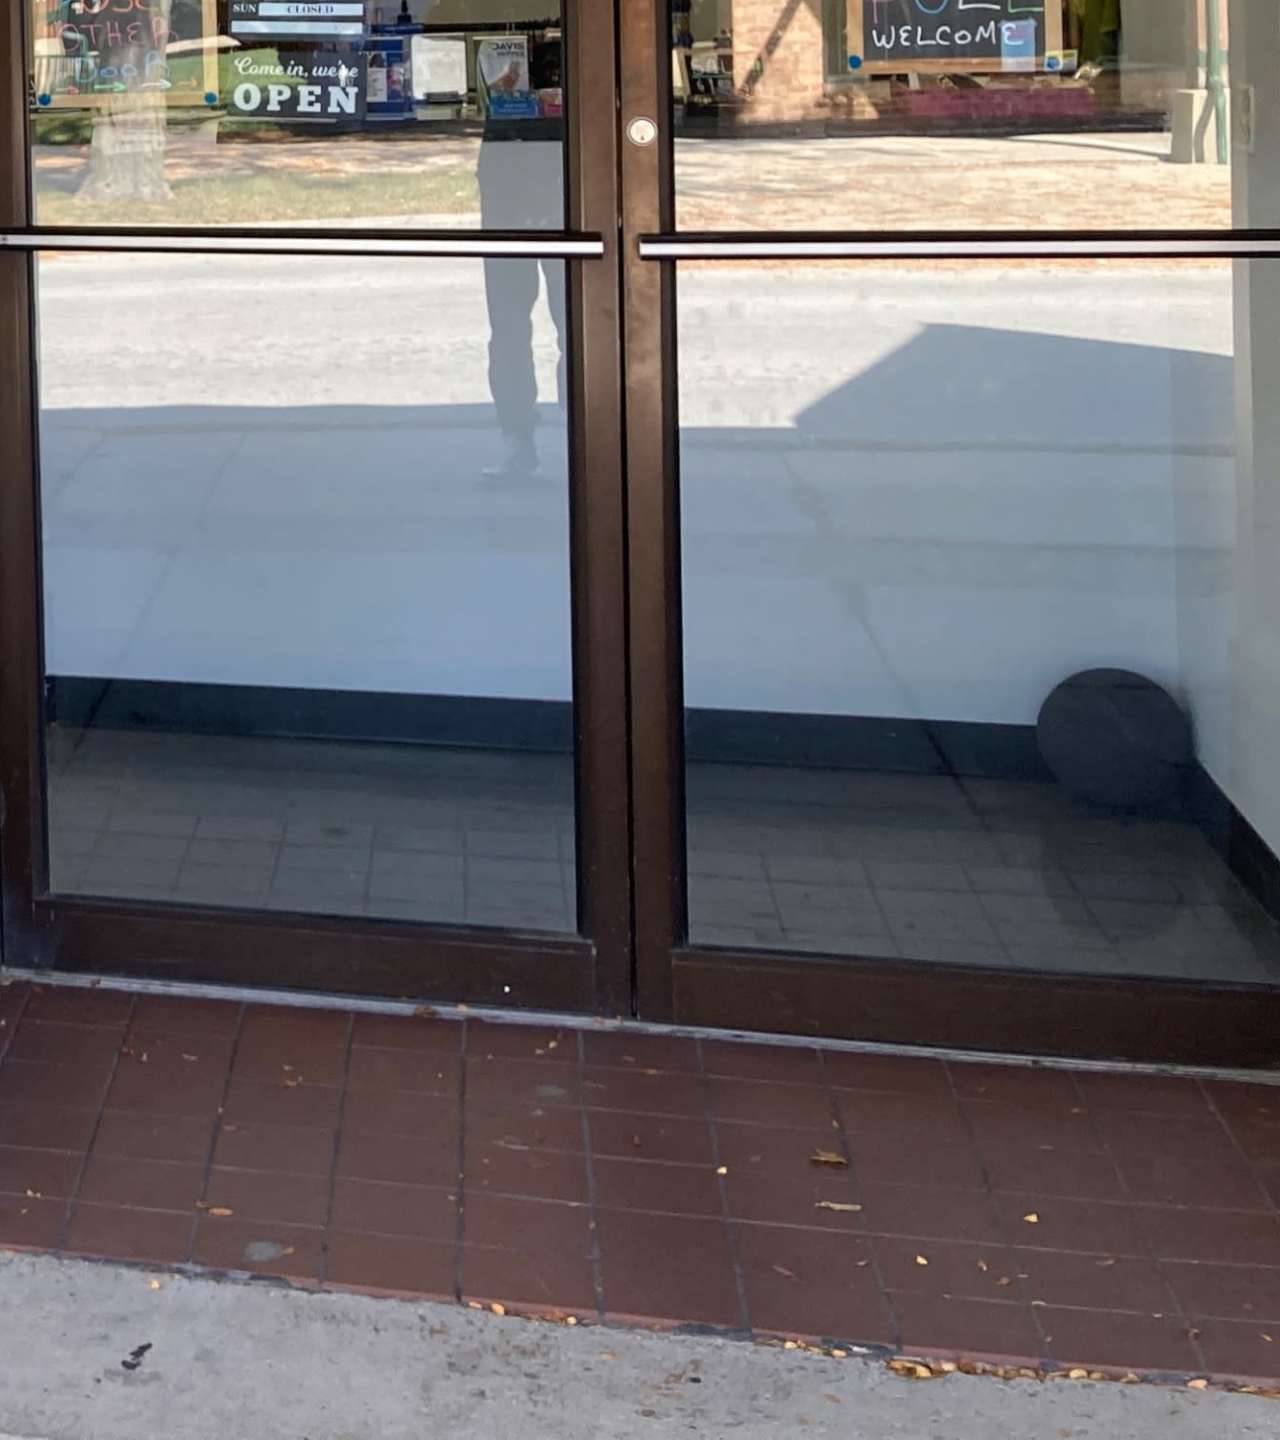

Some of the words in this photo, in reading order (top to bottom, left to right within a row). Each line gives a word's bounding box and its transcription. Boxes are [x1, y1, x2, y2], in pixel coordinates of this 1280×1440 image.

[232, 4, 257, 13] SUN
[287, 5, 335, 14] CLOSED
[57, 16, 180, 52] OTHER
[872, 19, 1024, 49] WELCOME
[234, 56, 285, 76] Come
[286, 59, 309, 78] in,
[233, 82, 359, 114] OPEN
